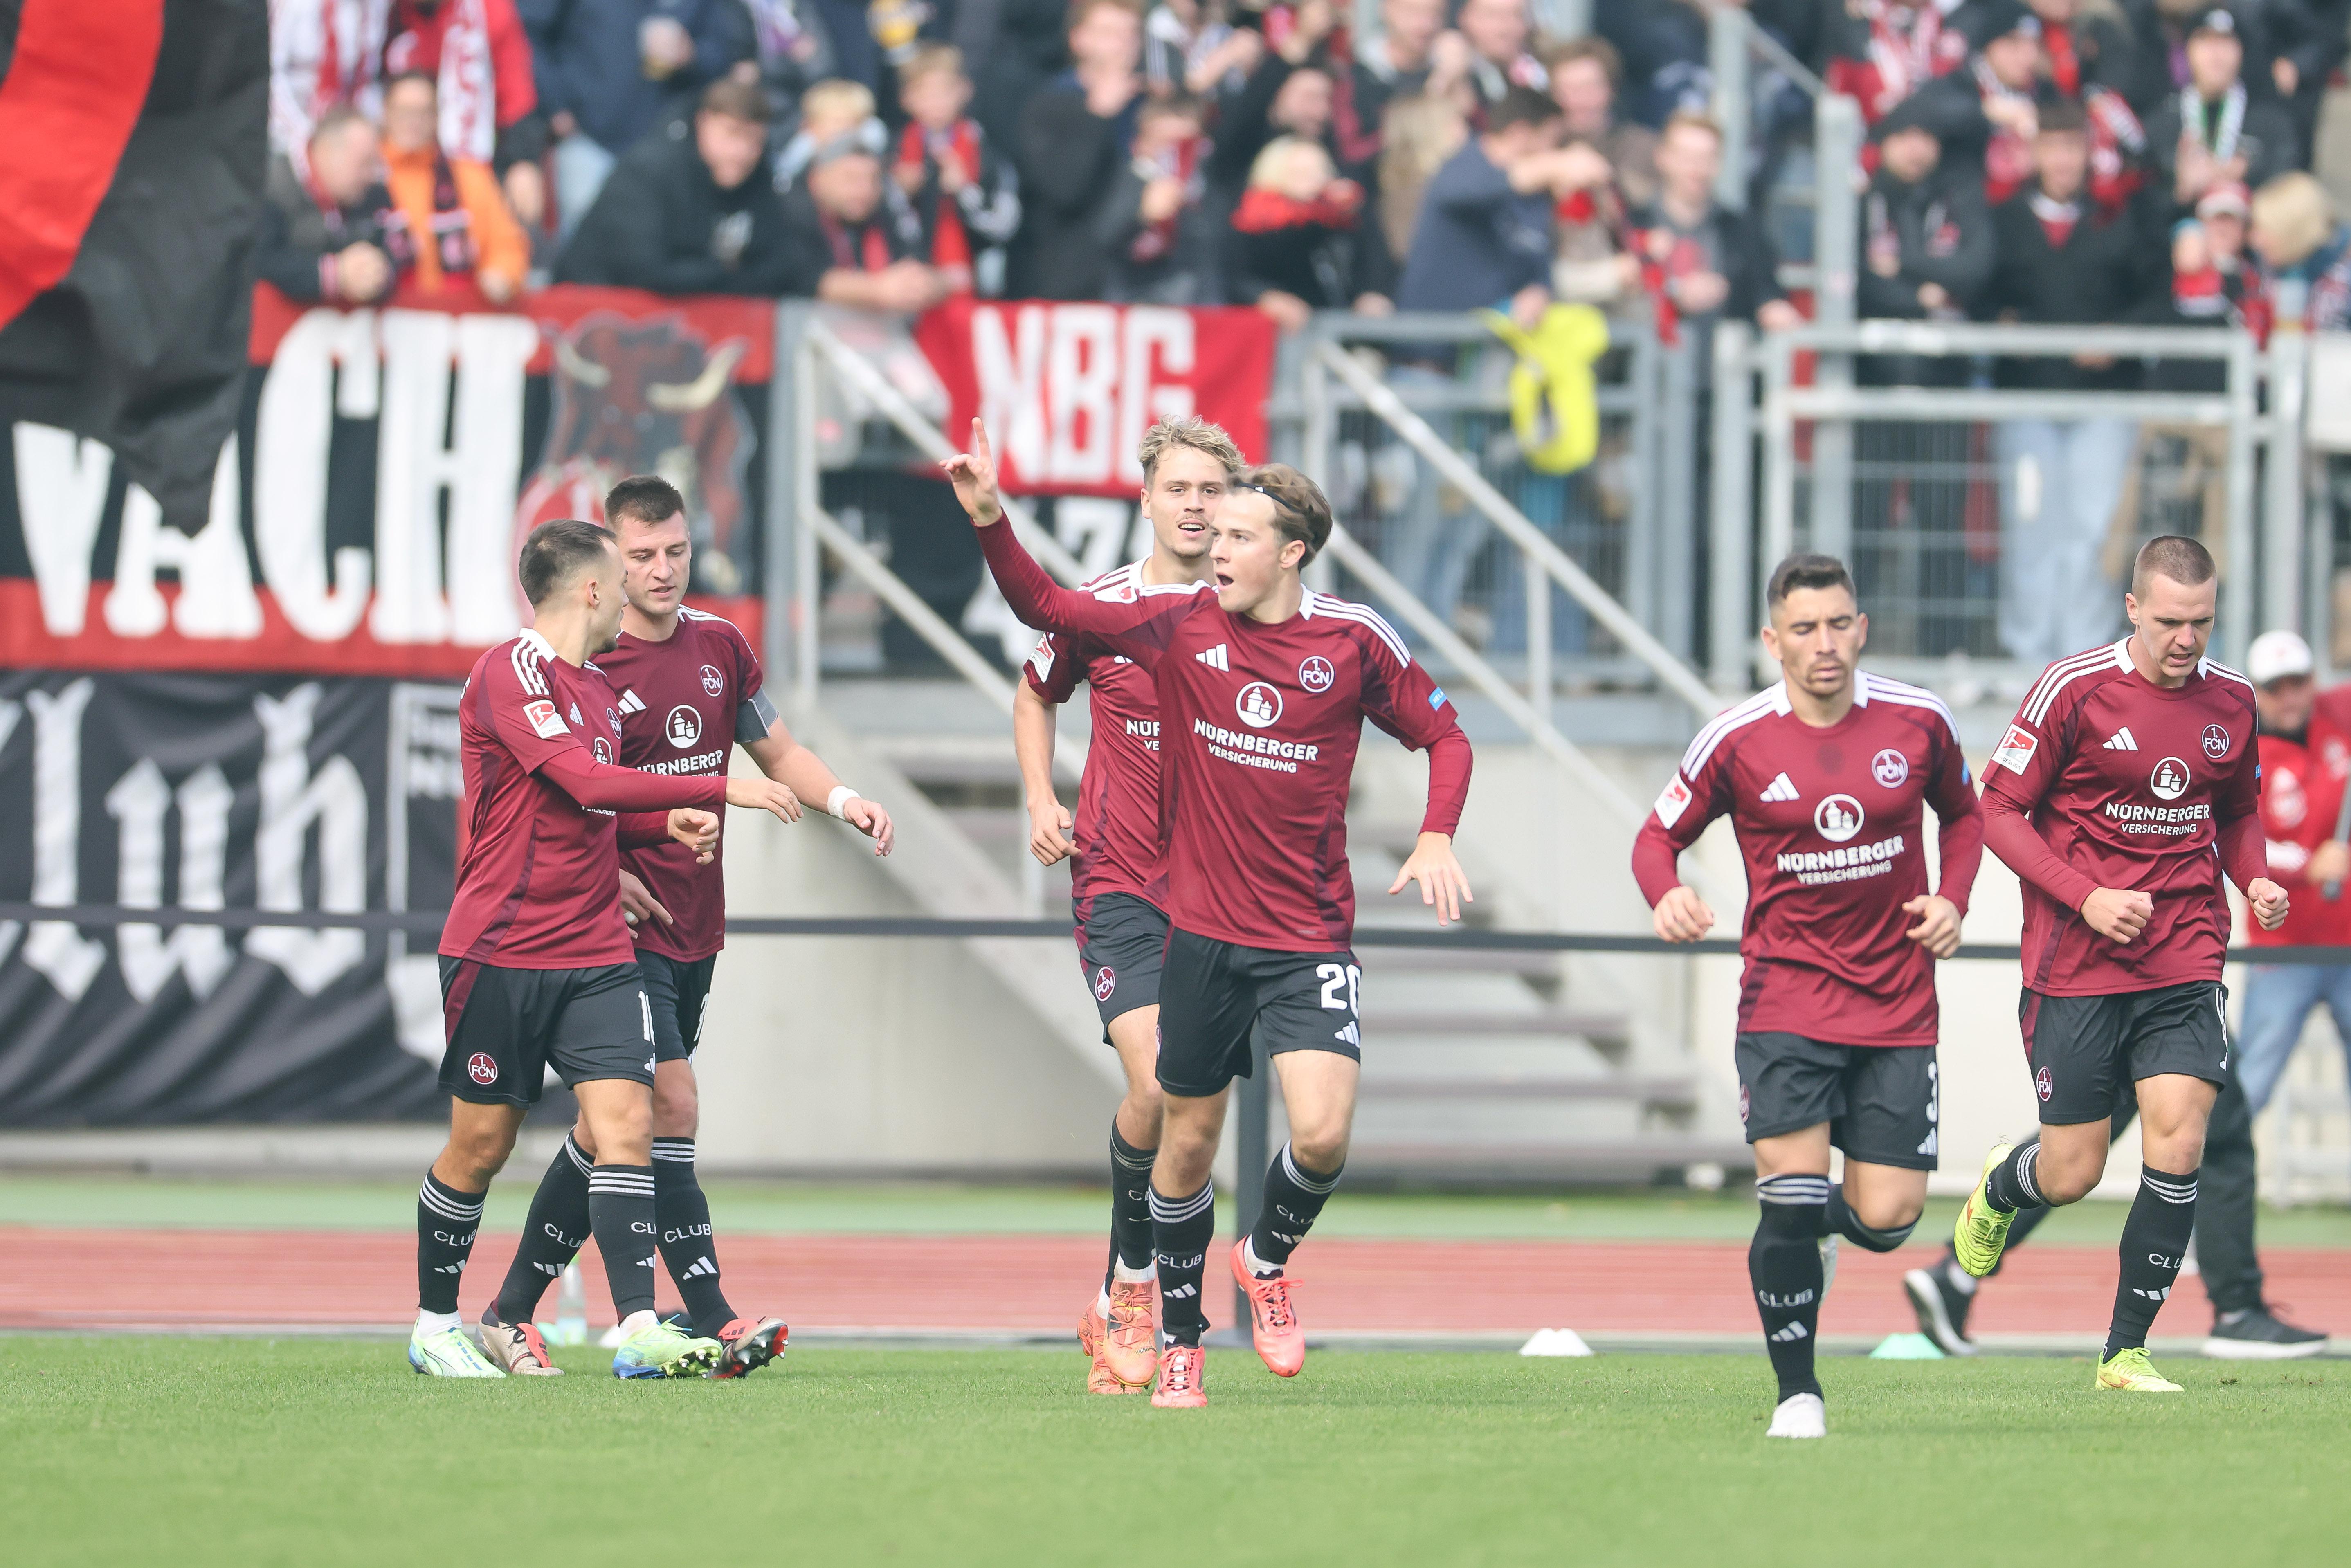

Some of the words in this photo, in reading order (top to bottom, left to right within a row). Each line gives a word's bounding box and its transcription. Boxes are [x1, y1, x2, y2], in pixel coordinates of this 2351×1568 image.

[970, 304, 1195, 485] NBG
[1312, 659, 1321, 671] 1.
[704, 667, 712, 678] 1.
[1303, 670, 1330, 684] FCN
[703, 677, 721, 690] FCN
[1193, 717, 1319, 762] NÜRNBERGER
[2211, 727, 2218, 738] 1.
[2205, 737, 2225, 750] FCN
[1207, 742, 1297, 773] VERSICHERUNG
[2105, 802, 2210, 822] NÜRNBERGER
[2121, 823, 2197, 836] VERSICHERUNG
[0, 677, 366, 1005] lub
[1776, 834, 1905, 872] NÜRNBERGER
[1796, 859, 1892, 885] VERSICHERUNG
[1100, 971, 1106, 981] 1.
[1097, 976, 1114, 997] FCN
[1315, 963, 1361, 1020] 20
[479, 1056, 486, 1067] 1.
[472, 1064, 494, 1078] FCN
[2043, 1070, 2047, 1081] 1.
[2039, 1081, 2051, 1093] FCN
[664, 1223, 712, 1243] CLUB
[1158, 1254, 1202, 1269] CLUB
